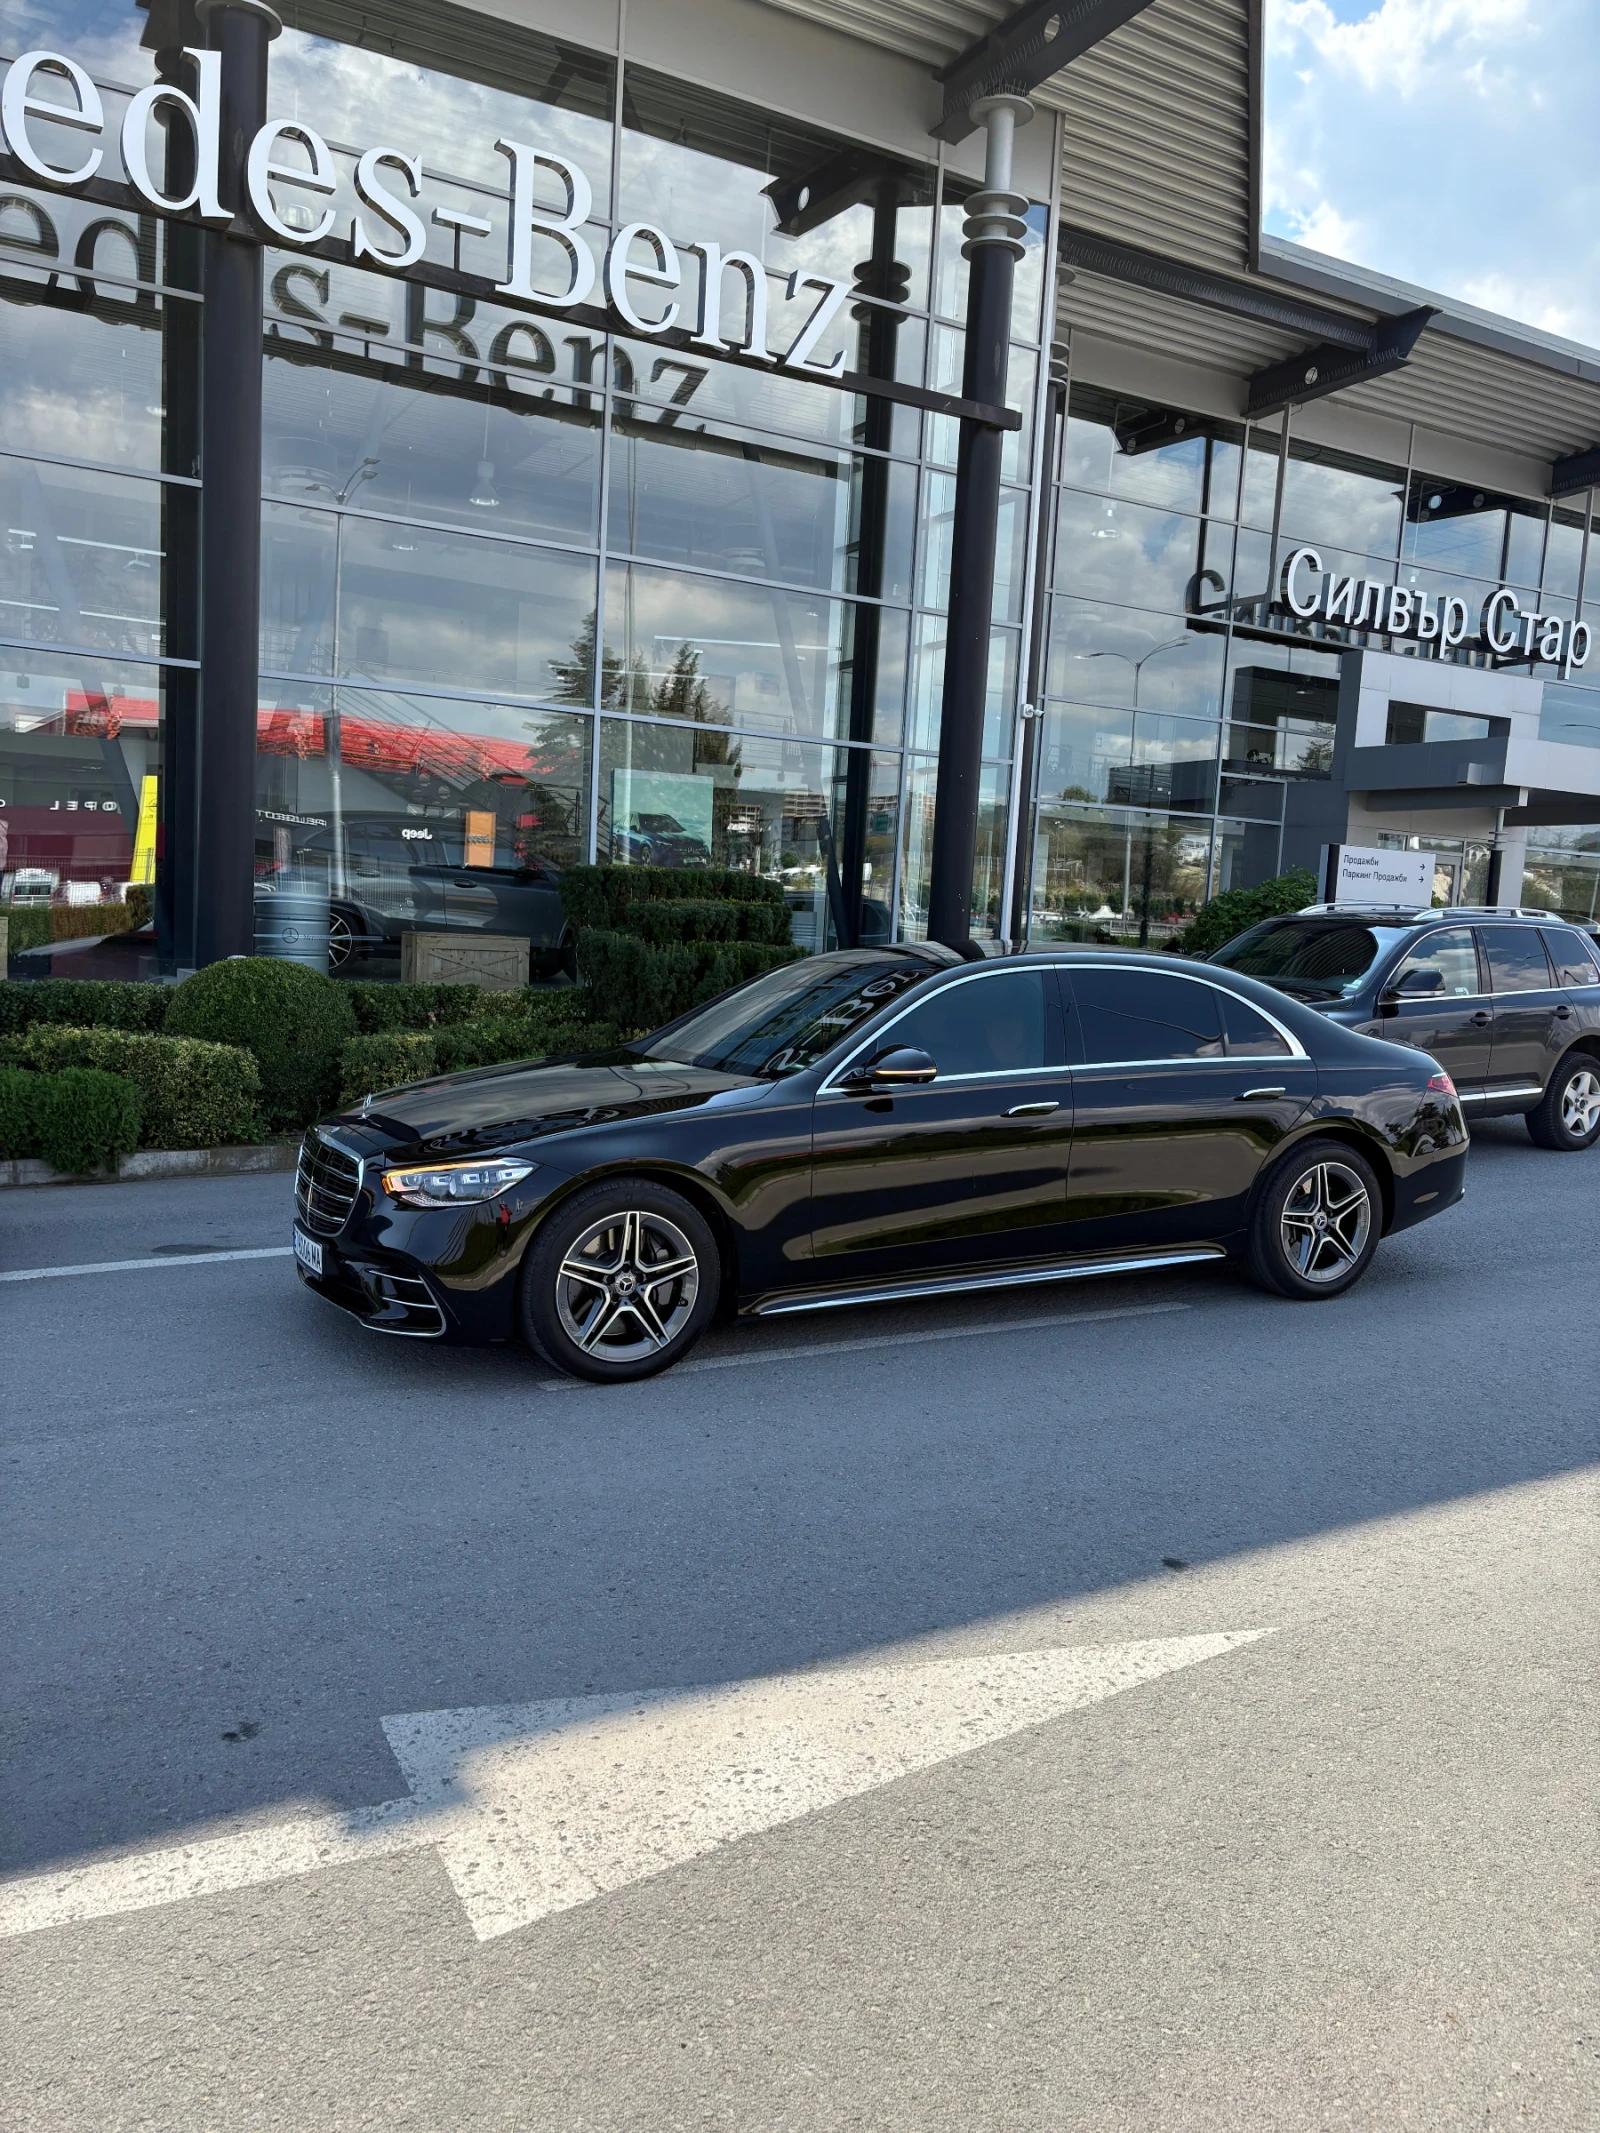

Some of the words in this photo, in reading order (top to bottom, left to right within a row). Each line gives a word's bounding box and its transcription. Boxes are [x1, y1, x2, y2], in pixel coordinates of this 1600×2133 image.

[1281, 546, 1469, 660] Силвър
[1480, 588, 1592, 681] Стар
[1343, 854, 1380, 867] Продажби
[1342, 868, 1372, 881] Паркинг
[1373, 871, 1408, 883] Продажби
